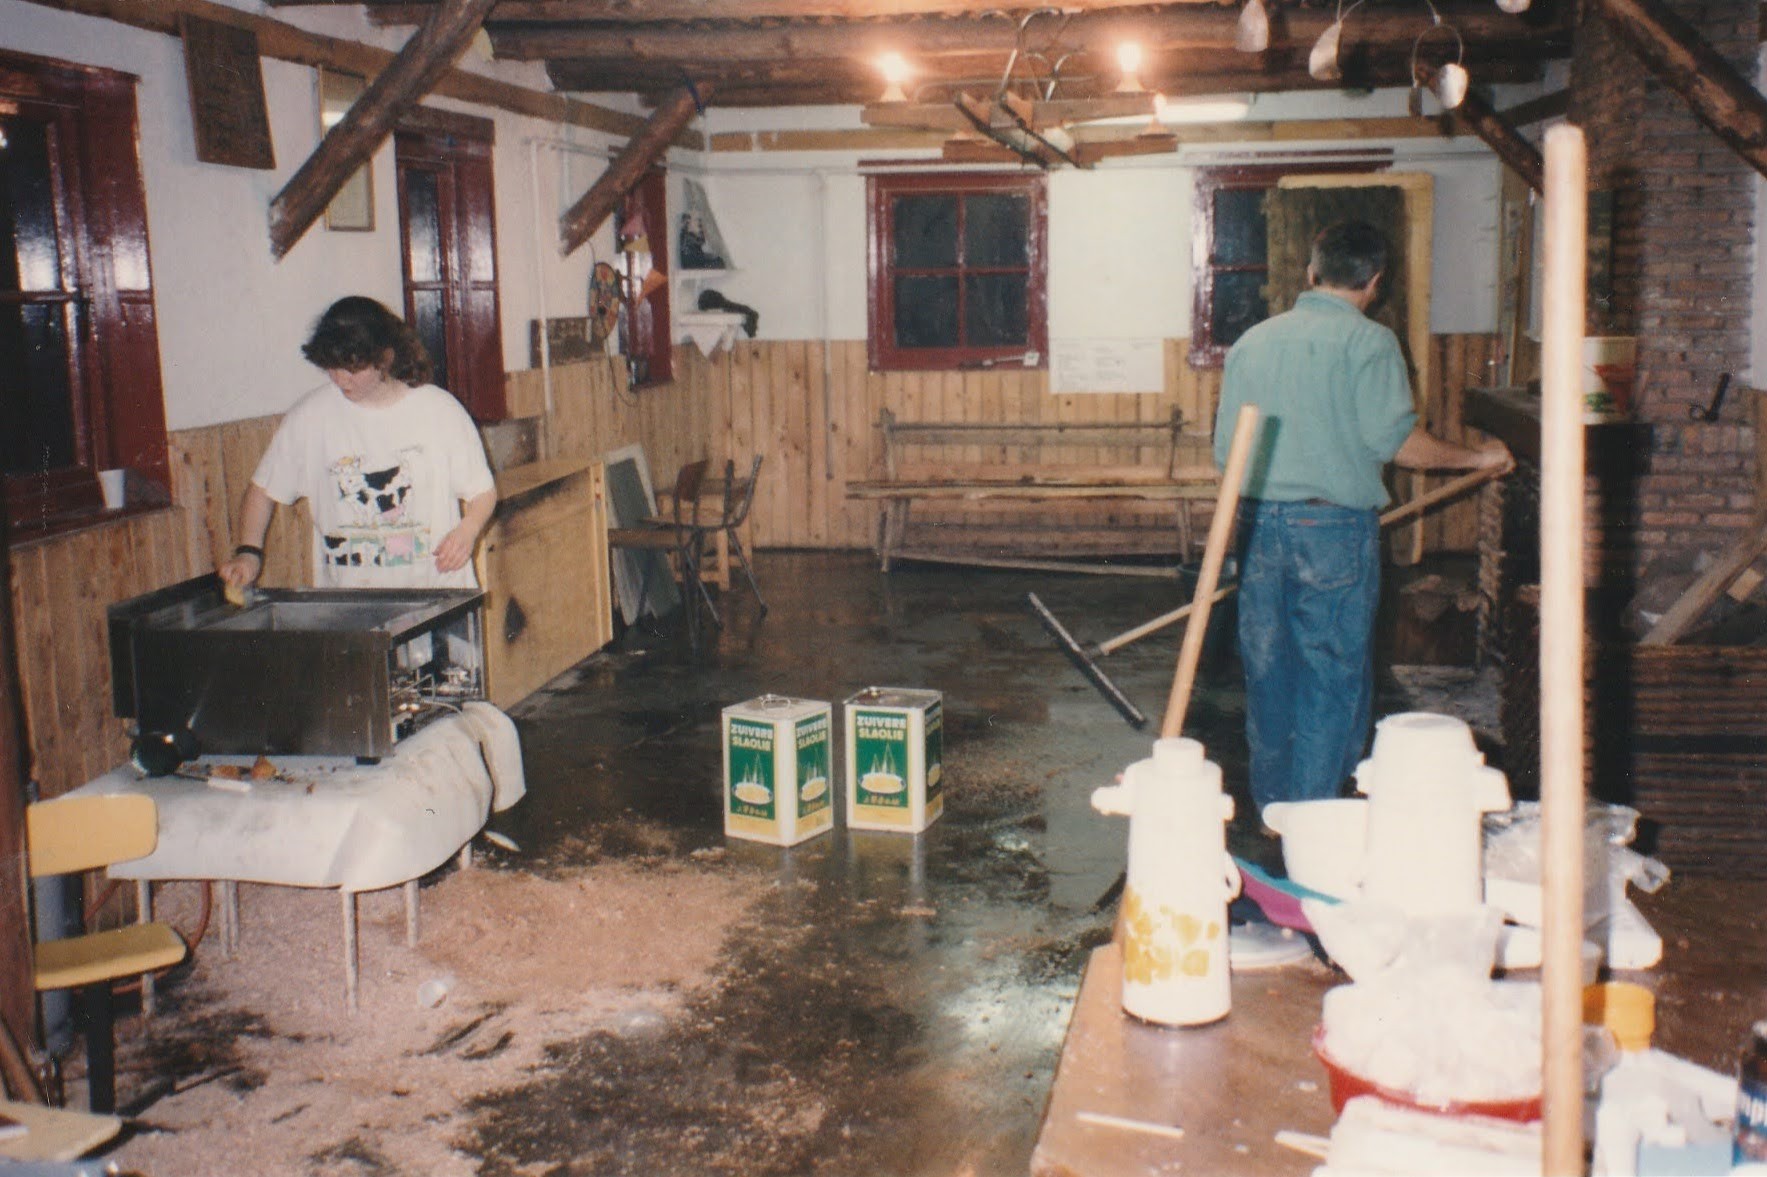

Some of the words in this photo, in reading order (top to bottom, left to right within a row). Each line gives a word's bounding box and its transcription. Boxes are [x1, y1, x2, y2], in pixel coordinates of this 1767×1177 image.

[856, 715, 907, 729] ZUIVERE
[731, 723, 774, 740] ZUIVERE
[858, 728, 904, 741] SLAOLIE
[732, 735, 771, 752] SLAOLIE
